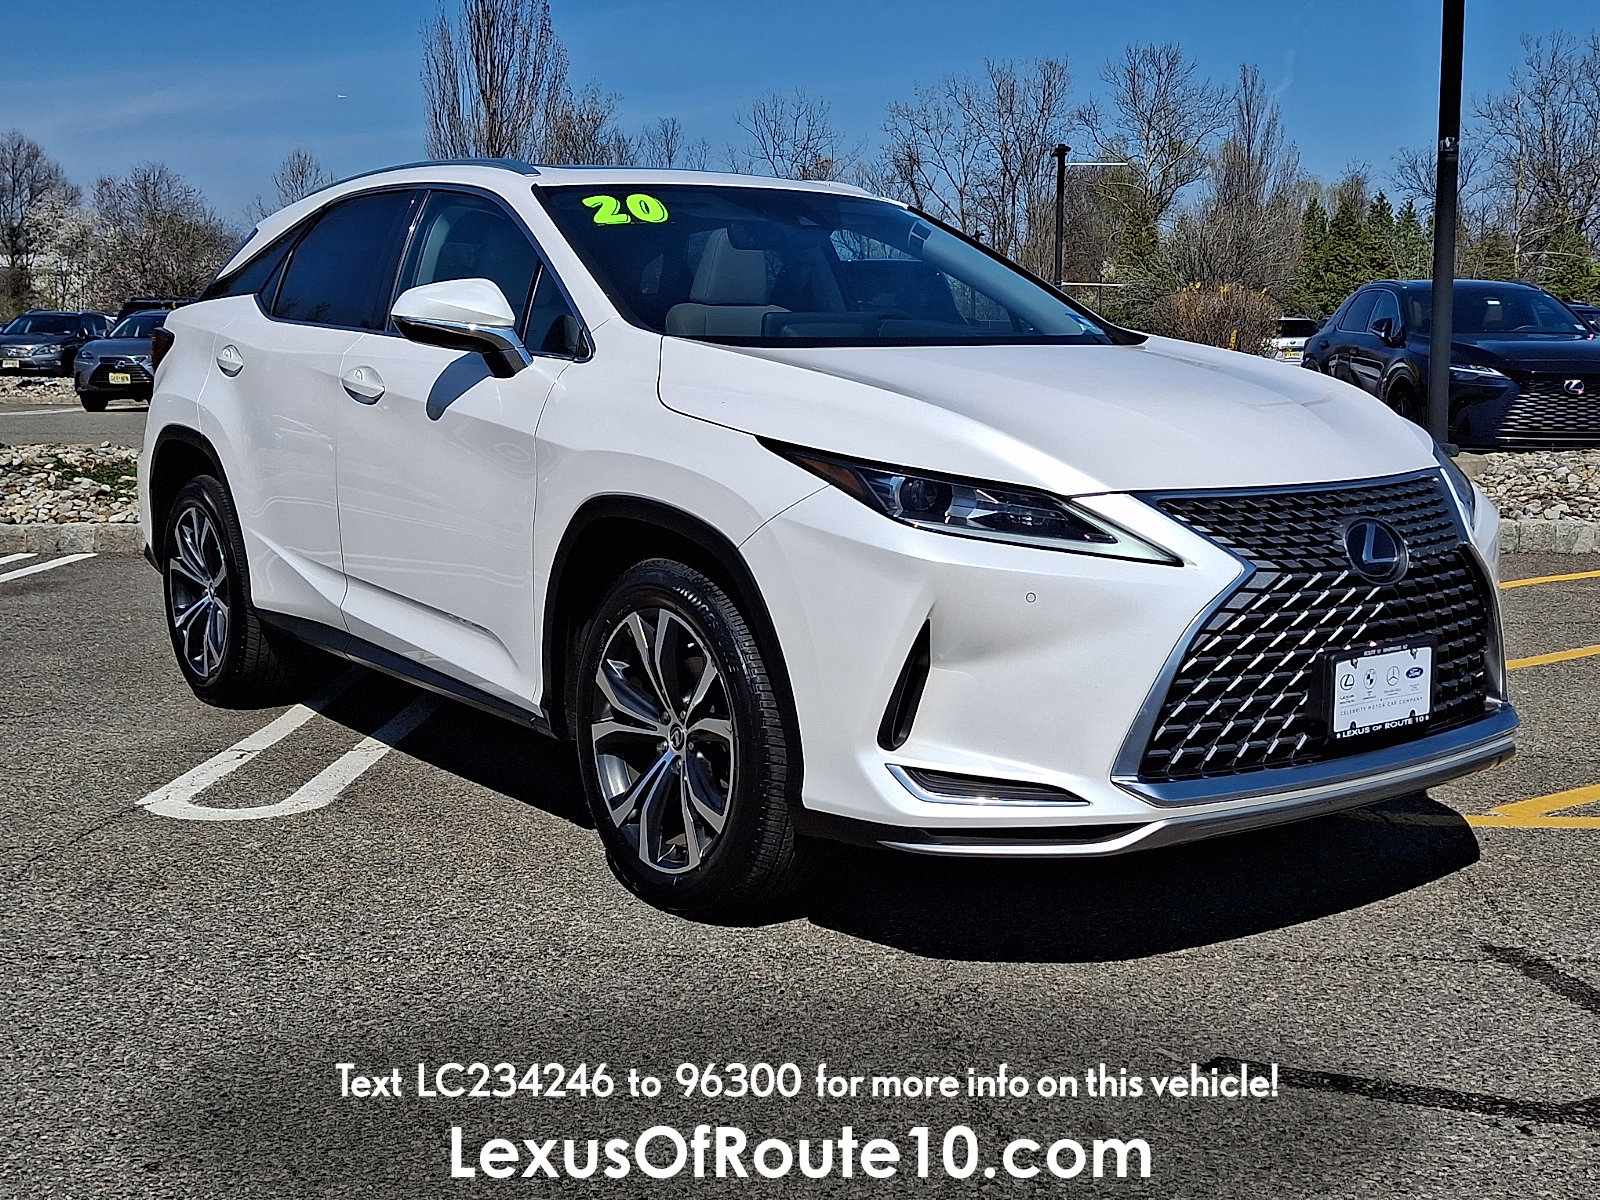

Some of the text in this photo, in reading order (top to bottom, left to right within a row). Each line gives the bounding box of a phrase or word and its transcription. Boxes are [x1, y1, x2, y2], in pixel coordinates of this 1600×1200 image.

[582, 193, 669, 225] 20
[1340, 706, 1366, 716] CELEBRITY
[1368, 702, 1386, 710] MOTOR
[1399, 696, 1424, 705] COMPANY
[1342, 715, 1424, 738] LEXUS OF ROUTE 10
